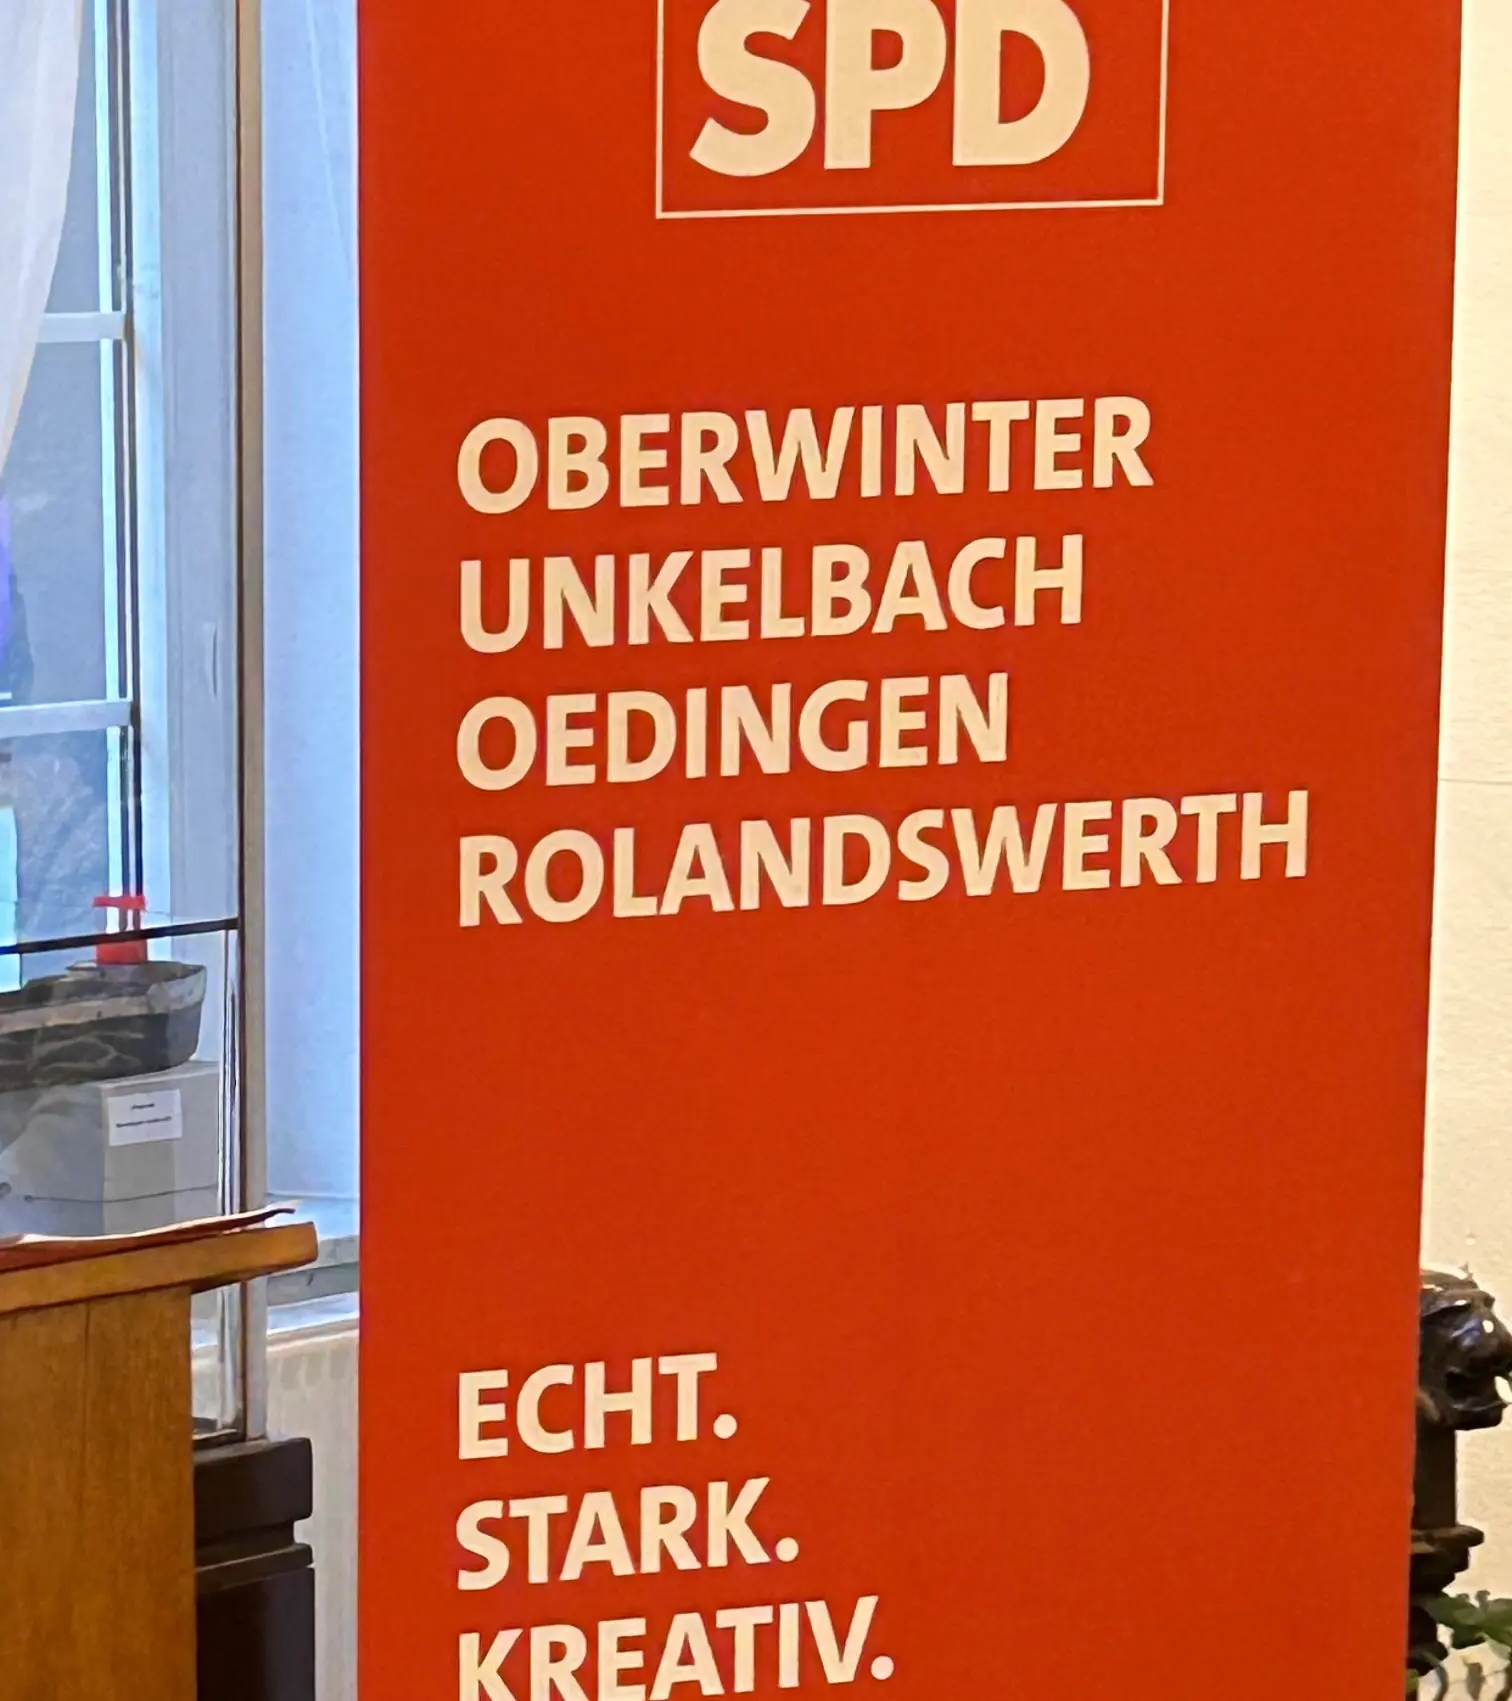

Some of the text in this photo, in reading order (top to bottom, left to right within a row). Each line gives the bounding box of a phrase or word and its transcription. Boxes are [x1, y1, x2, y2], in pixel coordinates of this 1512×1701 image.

[690, 0, 1089, 176] SPD
[458, 397, 1153, 513] OBERWINTER
[461, 535, 1082, 652] UNKELBACH
[458, 673, 1007, 790] OEDINGEN
[460, 791, 1307, 926] ROLANDSWERTH
[459, 1353, 736, 1459] ECHT.
[457, 1478, 798, 1589] STARK.
[460, 1596, 893, 1701] KREATIV.
